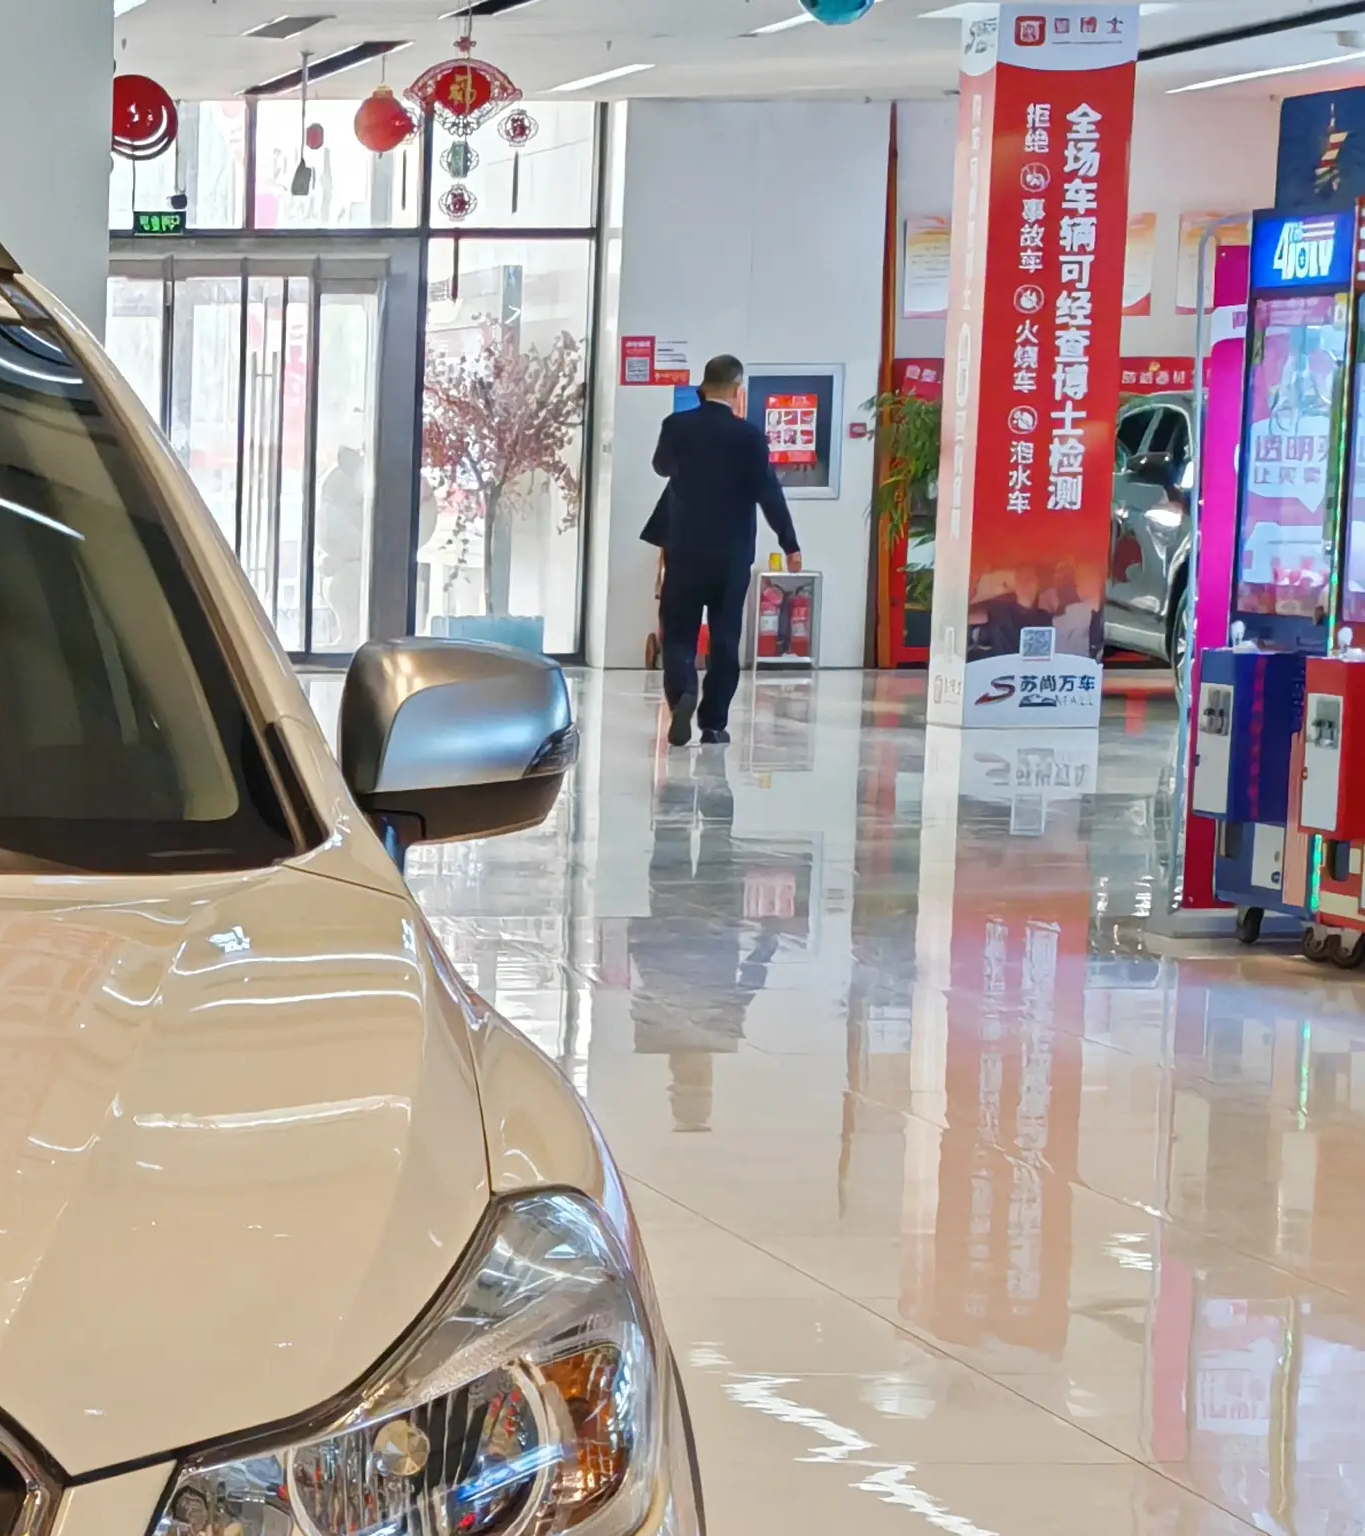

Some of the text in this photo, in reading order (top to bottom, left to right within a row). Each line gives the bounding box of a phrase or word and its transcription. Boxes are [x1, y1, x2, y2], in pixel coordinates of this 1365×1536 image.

[1007, 103, 1051, 514] 拒绝 事故车 火烧车 泡水车
[1047, 103, 1102, 510] 全场车辆可经查博士检测
